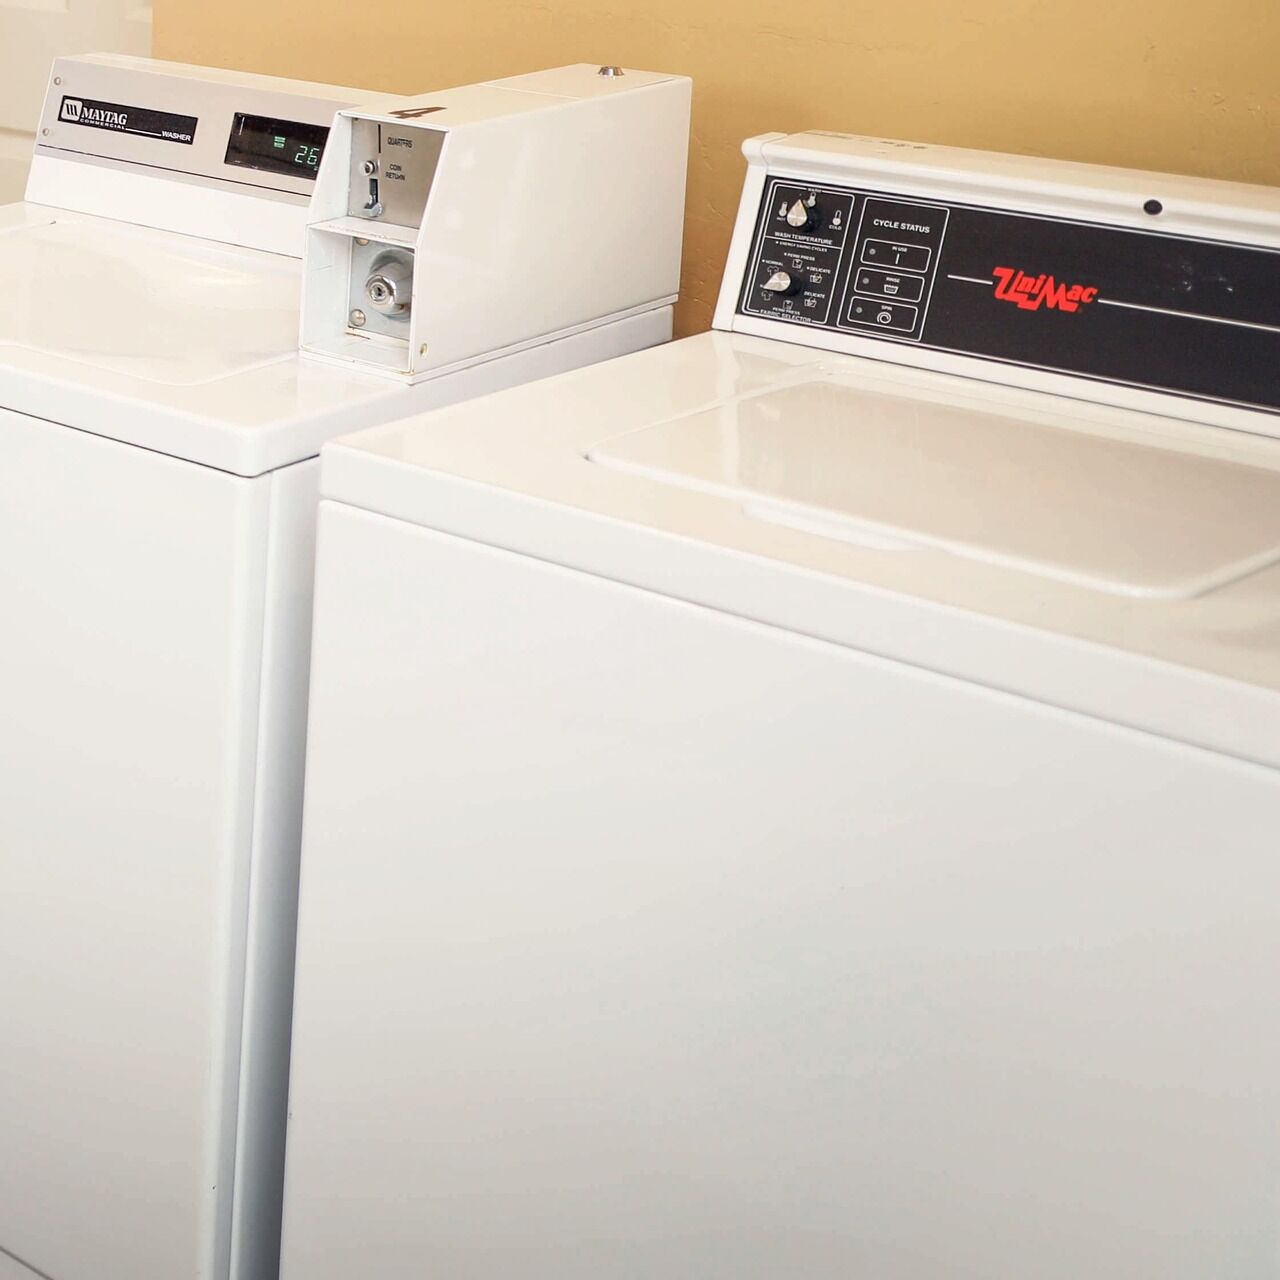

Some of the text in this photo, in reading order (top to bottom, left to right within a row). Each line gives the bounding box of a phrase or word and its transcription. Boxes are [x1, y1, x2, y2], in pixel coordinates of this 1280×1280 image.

[81, 107, 128, 125] MAYTAG
[80, 118, 127, 130] COMMERCIAL
[161, 130, 192, 141] WASHER
[294, 145, 320, 165] 26
[389, 163, 402, 171] COIN
[385, 171, 405, 181] RETURN
[873, 218, 931, 233] CYCLE STATUS
[791, 233, 833, 245] TEMPERATURE
[809, 266, 831, 274] DELICATE
[803, 291, 826, 299] DELICATE
[781, 312, 812, 323] SELECTOR
